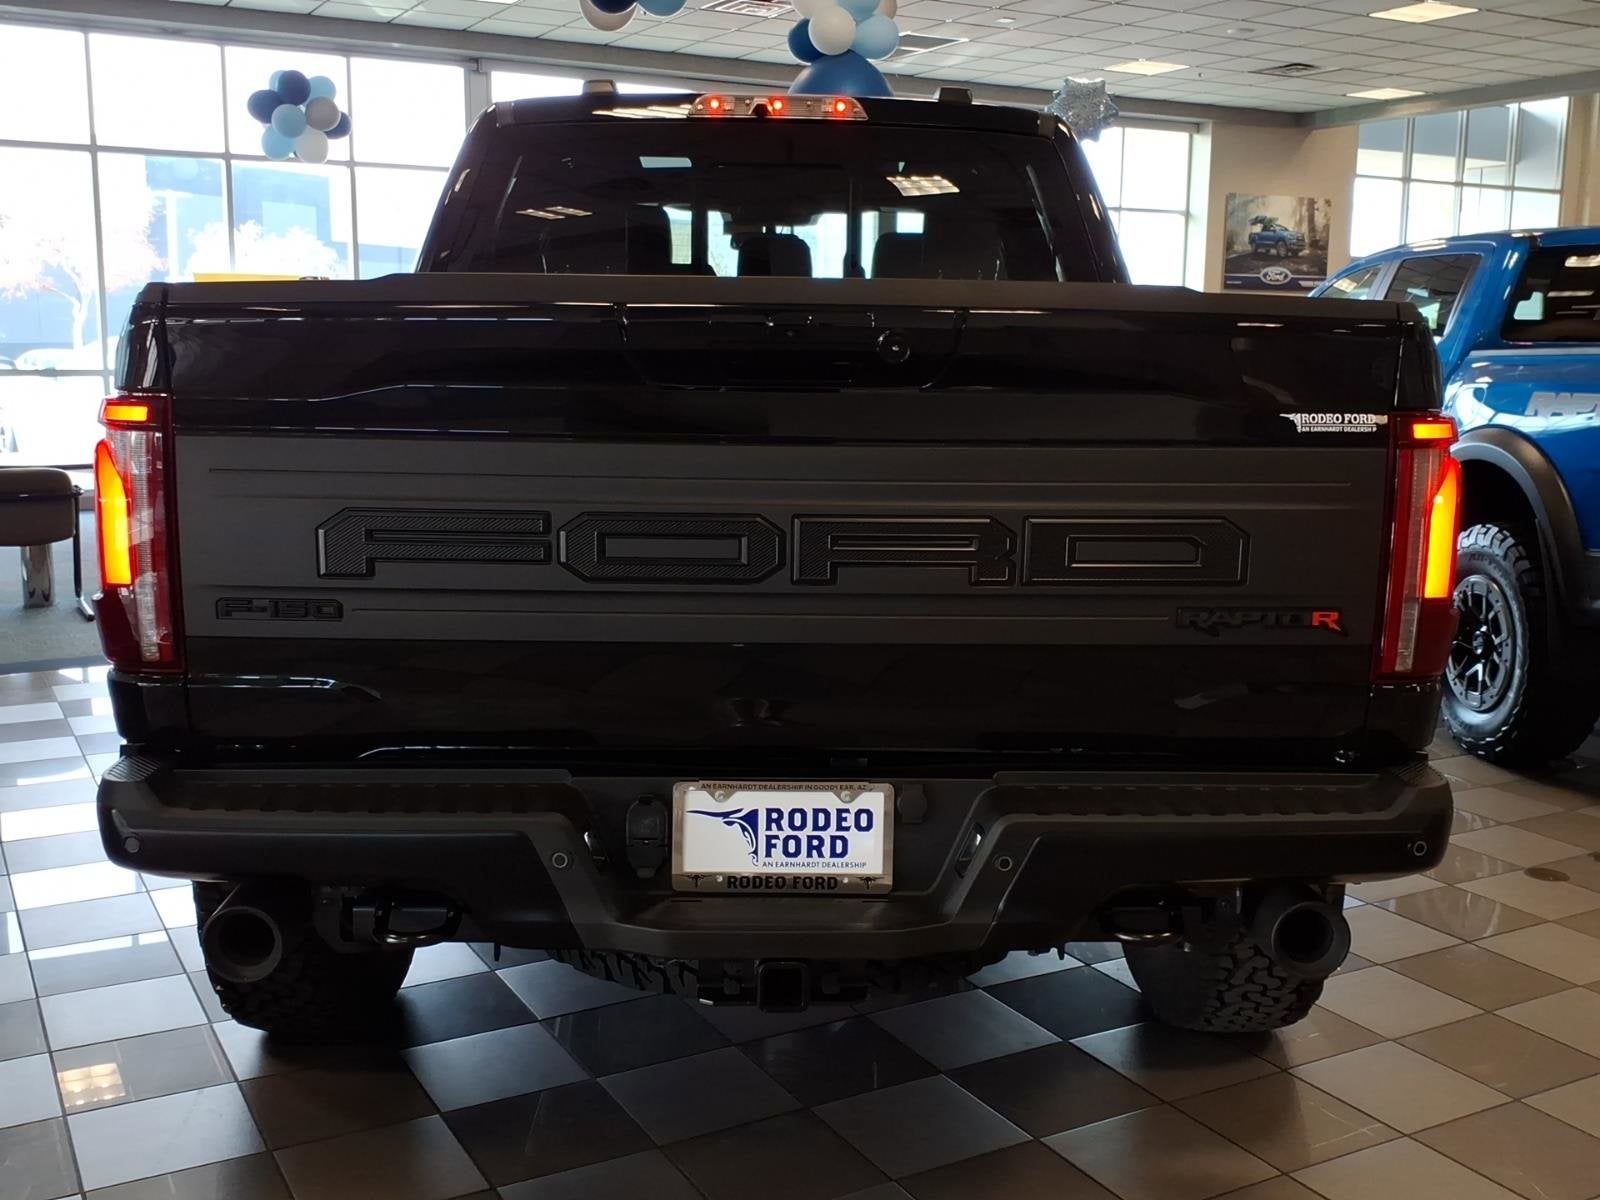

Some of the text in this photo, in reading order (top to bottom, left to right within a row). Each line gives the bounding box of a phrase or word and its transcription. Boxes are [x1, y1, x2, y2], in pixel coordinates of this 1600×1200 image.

[1301, 413, 1376, 424] RODEO FORD
[1522, 391, 1600, 428] RAP
[315, 506, 1250, 587] FORD
[215, 596, 343, 622] F-150
[1176, 606, 1346, 637] RAPTOR
[765, 807, 874, 832] RODEO
[765, 834, 849, 859] FORD
[726, 875, 838, 890] RODEO FORD
